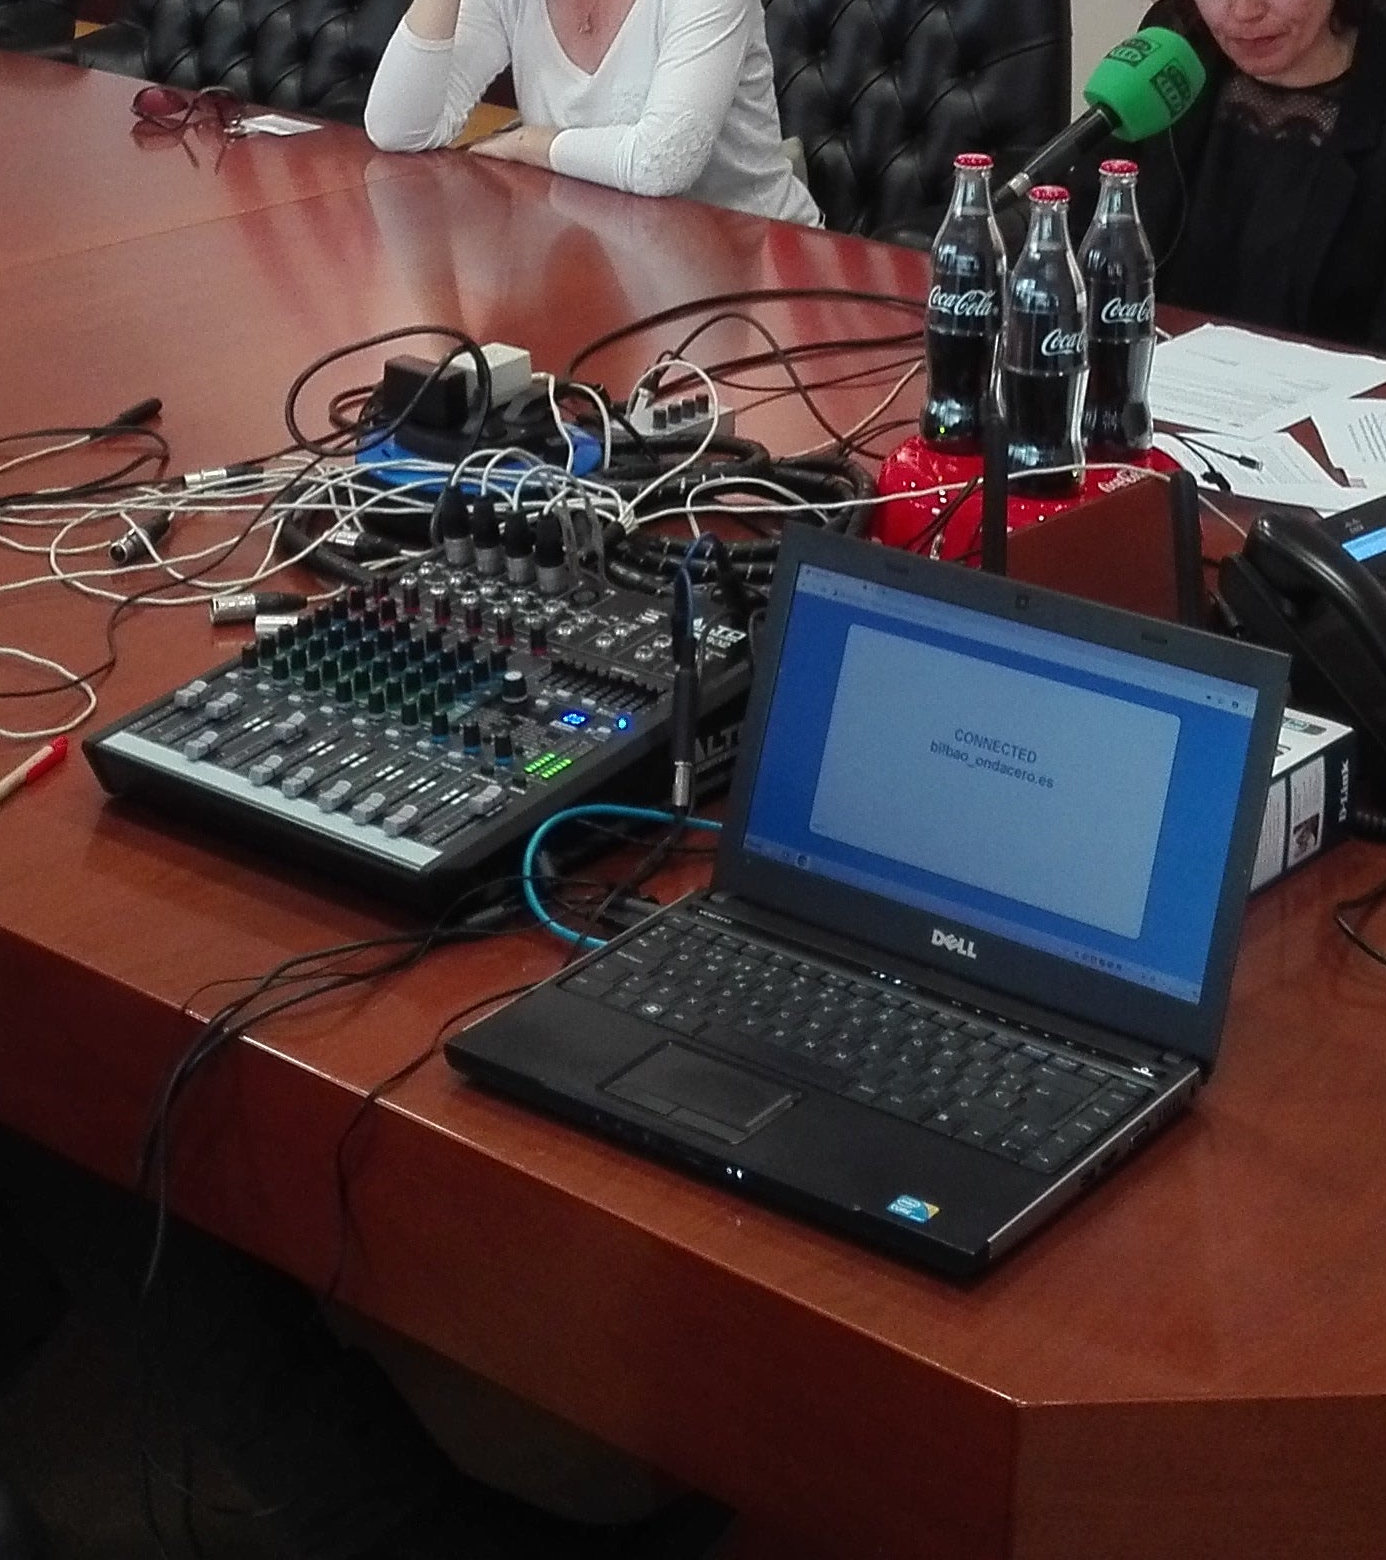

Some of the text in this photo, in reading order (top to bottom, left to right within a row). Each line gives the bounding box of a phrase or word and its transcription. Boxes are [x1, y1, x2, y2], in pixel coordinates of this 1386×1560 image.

[928, 284, 996, 317] Coca-Cola
[954, 728, 1037, 763] CONNECTED
[930, 740, 1054, 788] bilbao_ondacero.es
[931, 929, 977, 960] DELL
